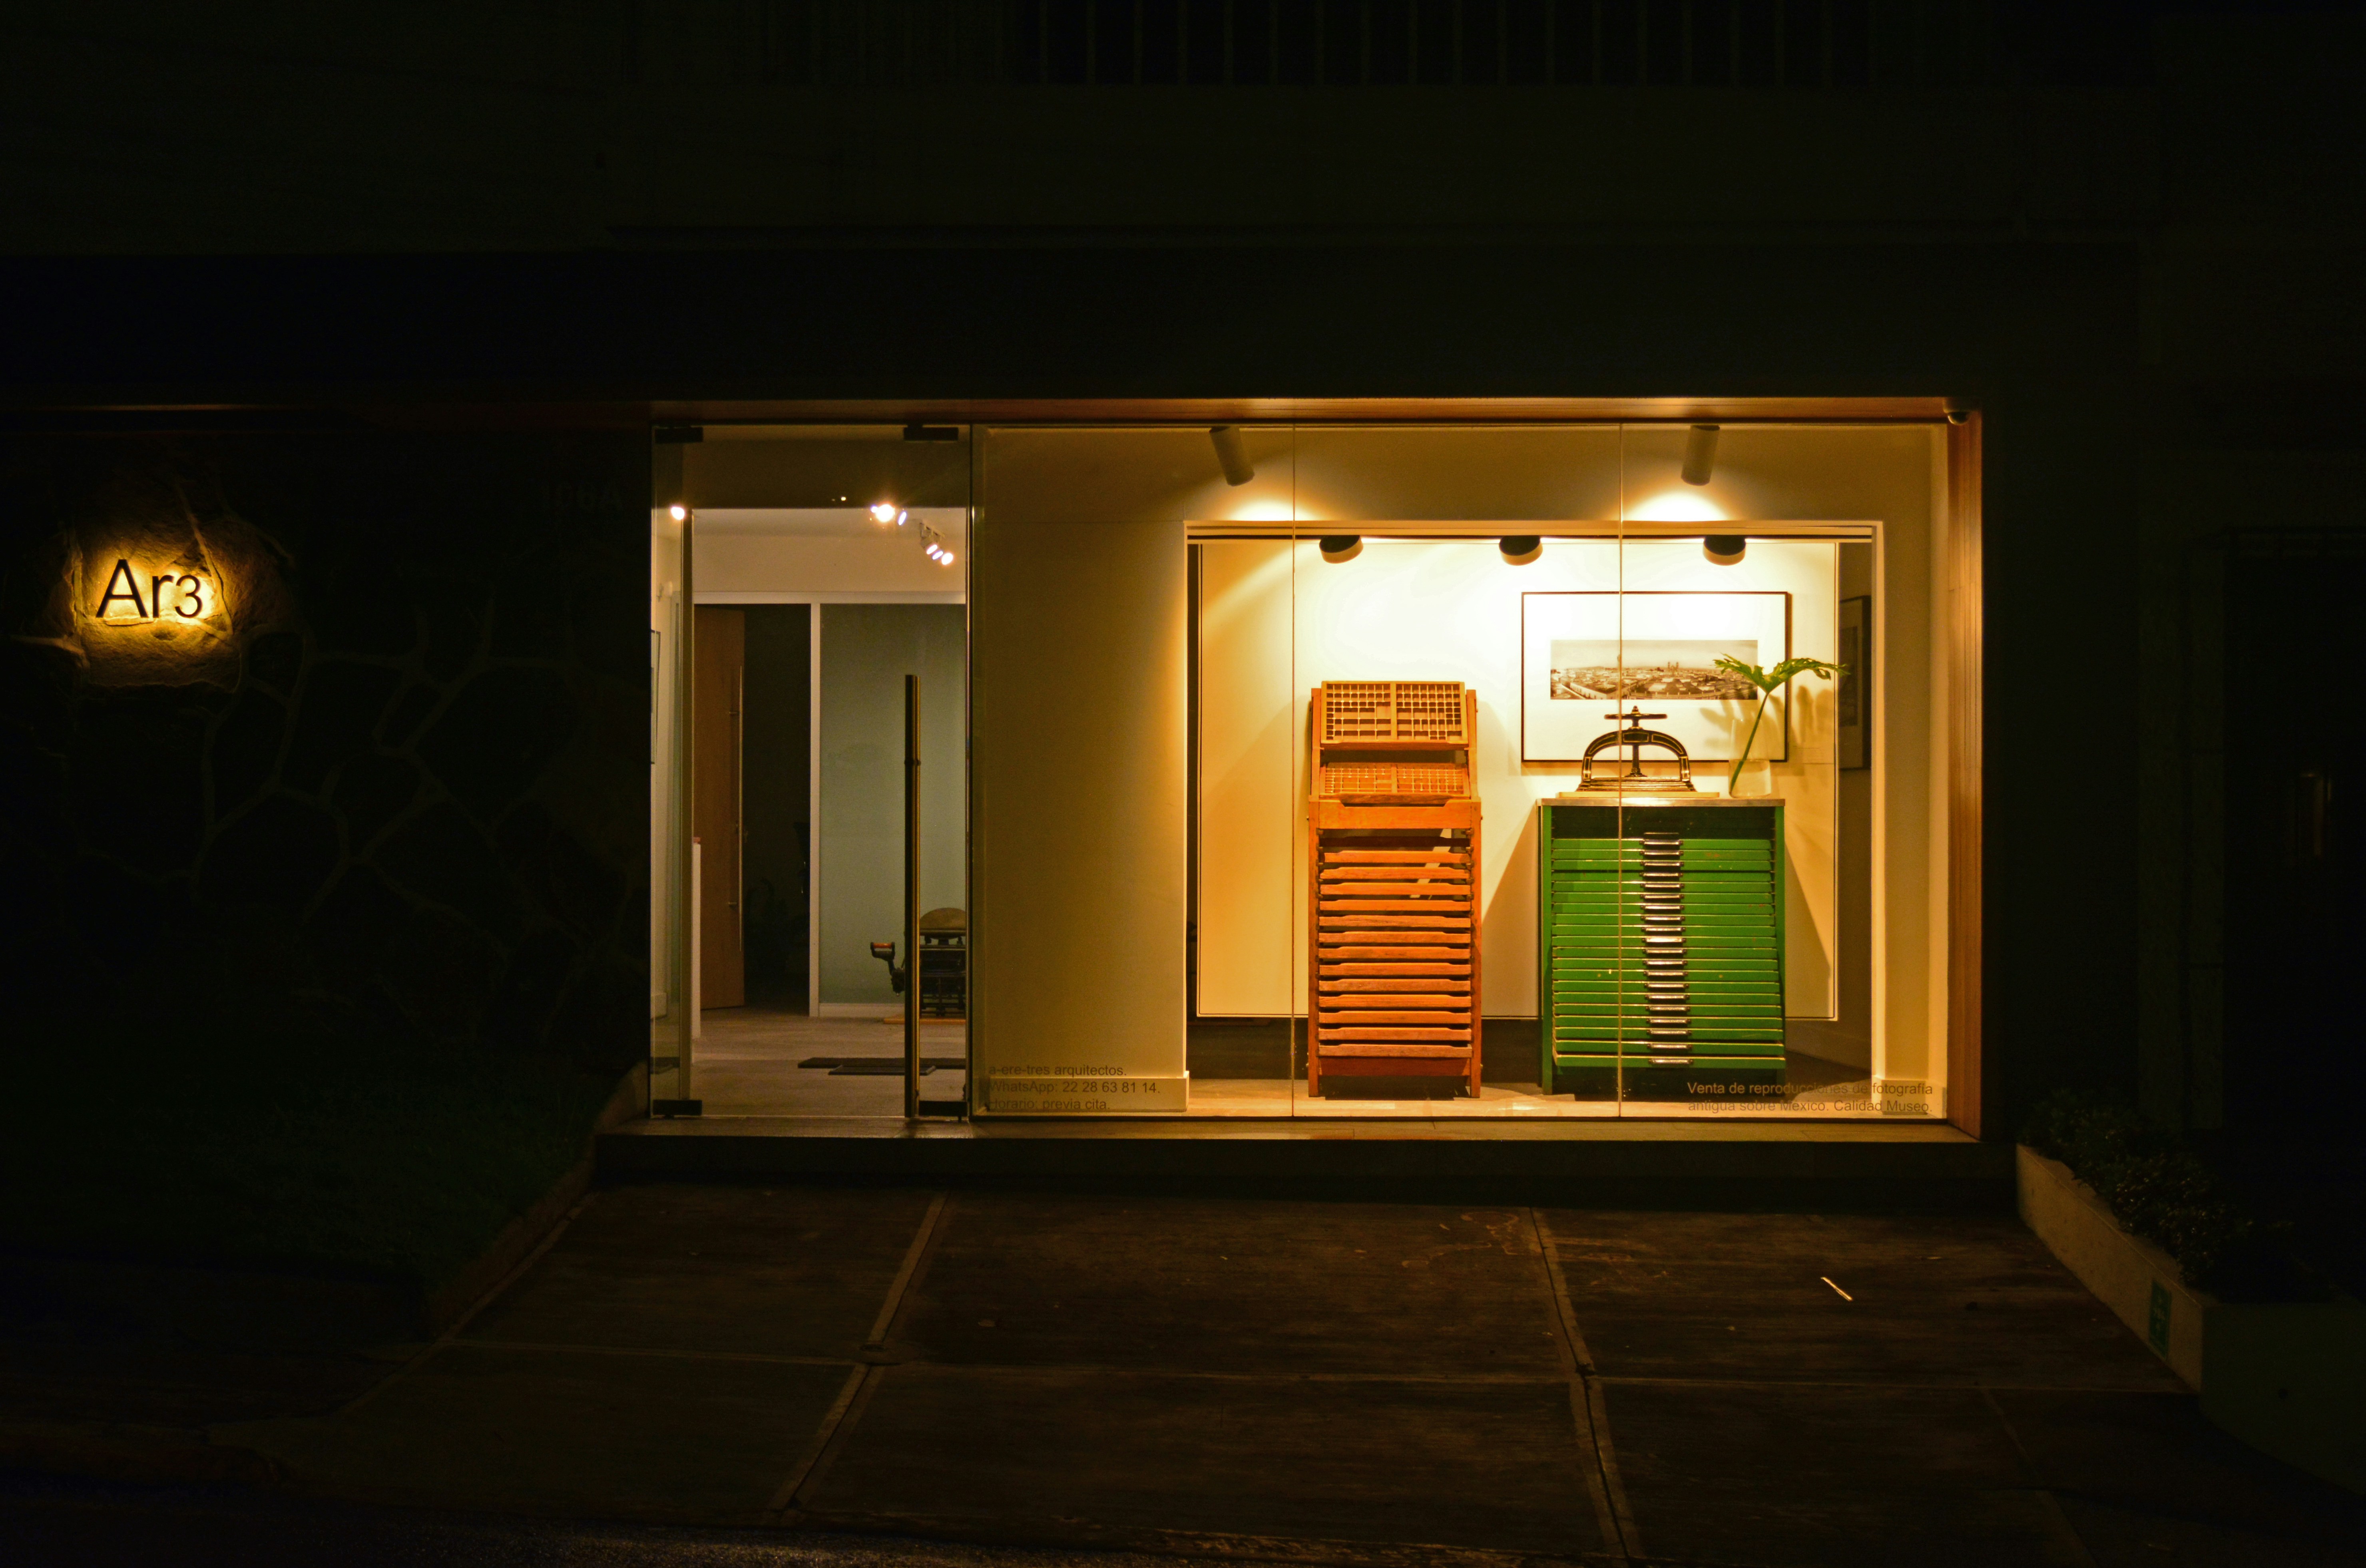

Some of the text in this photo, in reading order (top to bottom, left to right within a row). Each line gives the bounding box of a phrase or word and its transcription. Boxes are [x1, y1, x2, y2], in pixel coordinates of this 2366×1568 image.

[96, 559, 203, 619] Ar3
[989, 1064, 1127, 1077] a-ere-tres arquitectos.
[990, 1081, 1161, 1094] WhatsApp: 22 28 63 81 14.
[1687, 1082, 1933, 1097] Venta de reproducciones de fotografía
[1042, 1098, 1081, 1113] previa
[1085, 1099, 1110, 1110] cita.
[1688, 1099, 1736, 1114] antigua
[1739, 1099, 1776, 1112] sobre
[1834, 1099, 1882, 1112] Calidad
[1886, 1100, 1933, 1112] Museo.
